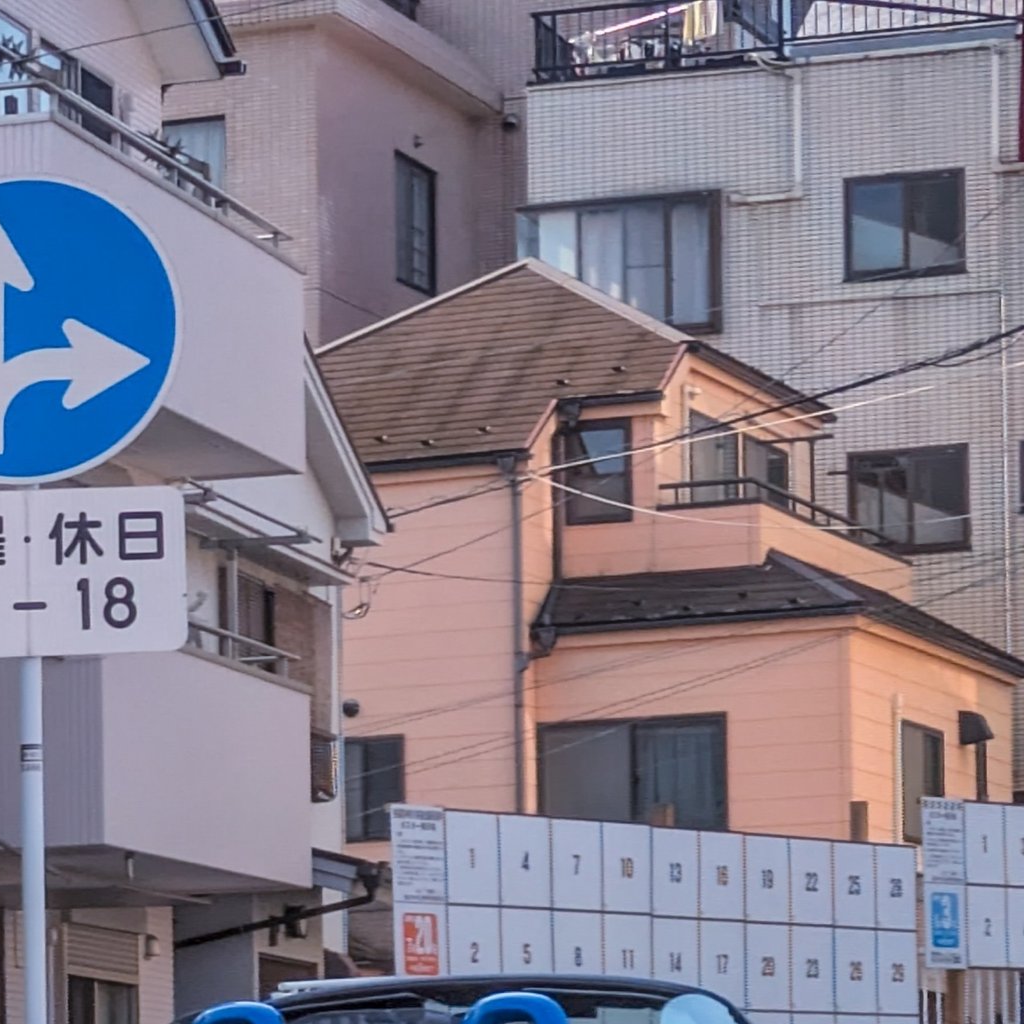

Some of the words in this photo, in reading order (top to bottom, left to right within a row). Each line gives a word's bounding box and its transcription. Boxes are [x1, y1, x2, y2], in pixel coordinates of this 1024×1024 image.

[521, 851, 530, 871] 4
[572, 854, 581, 875] 7
[620, 857, 634, 879] 10
[669, 862, 682, 883] 13
[805, 872, 819, 892] 22
[470, 942, 479, 963] 2
[522, 943, 532, 965] 5
[622, 949, 634, 970] 11
[716, 954, 729, 974] 17
